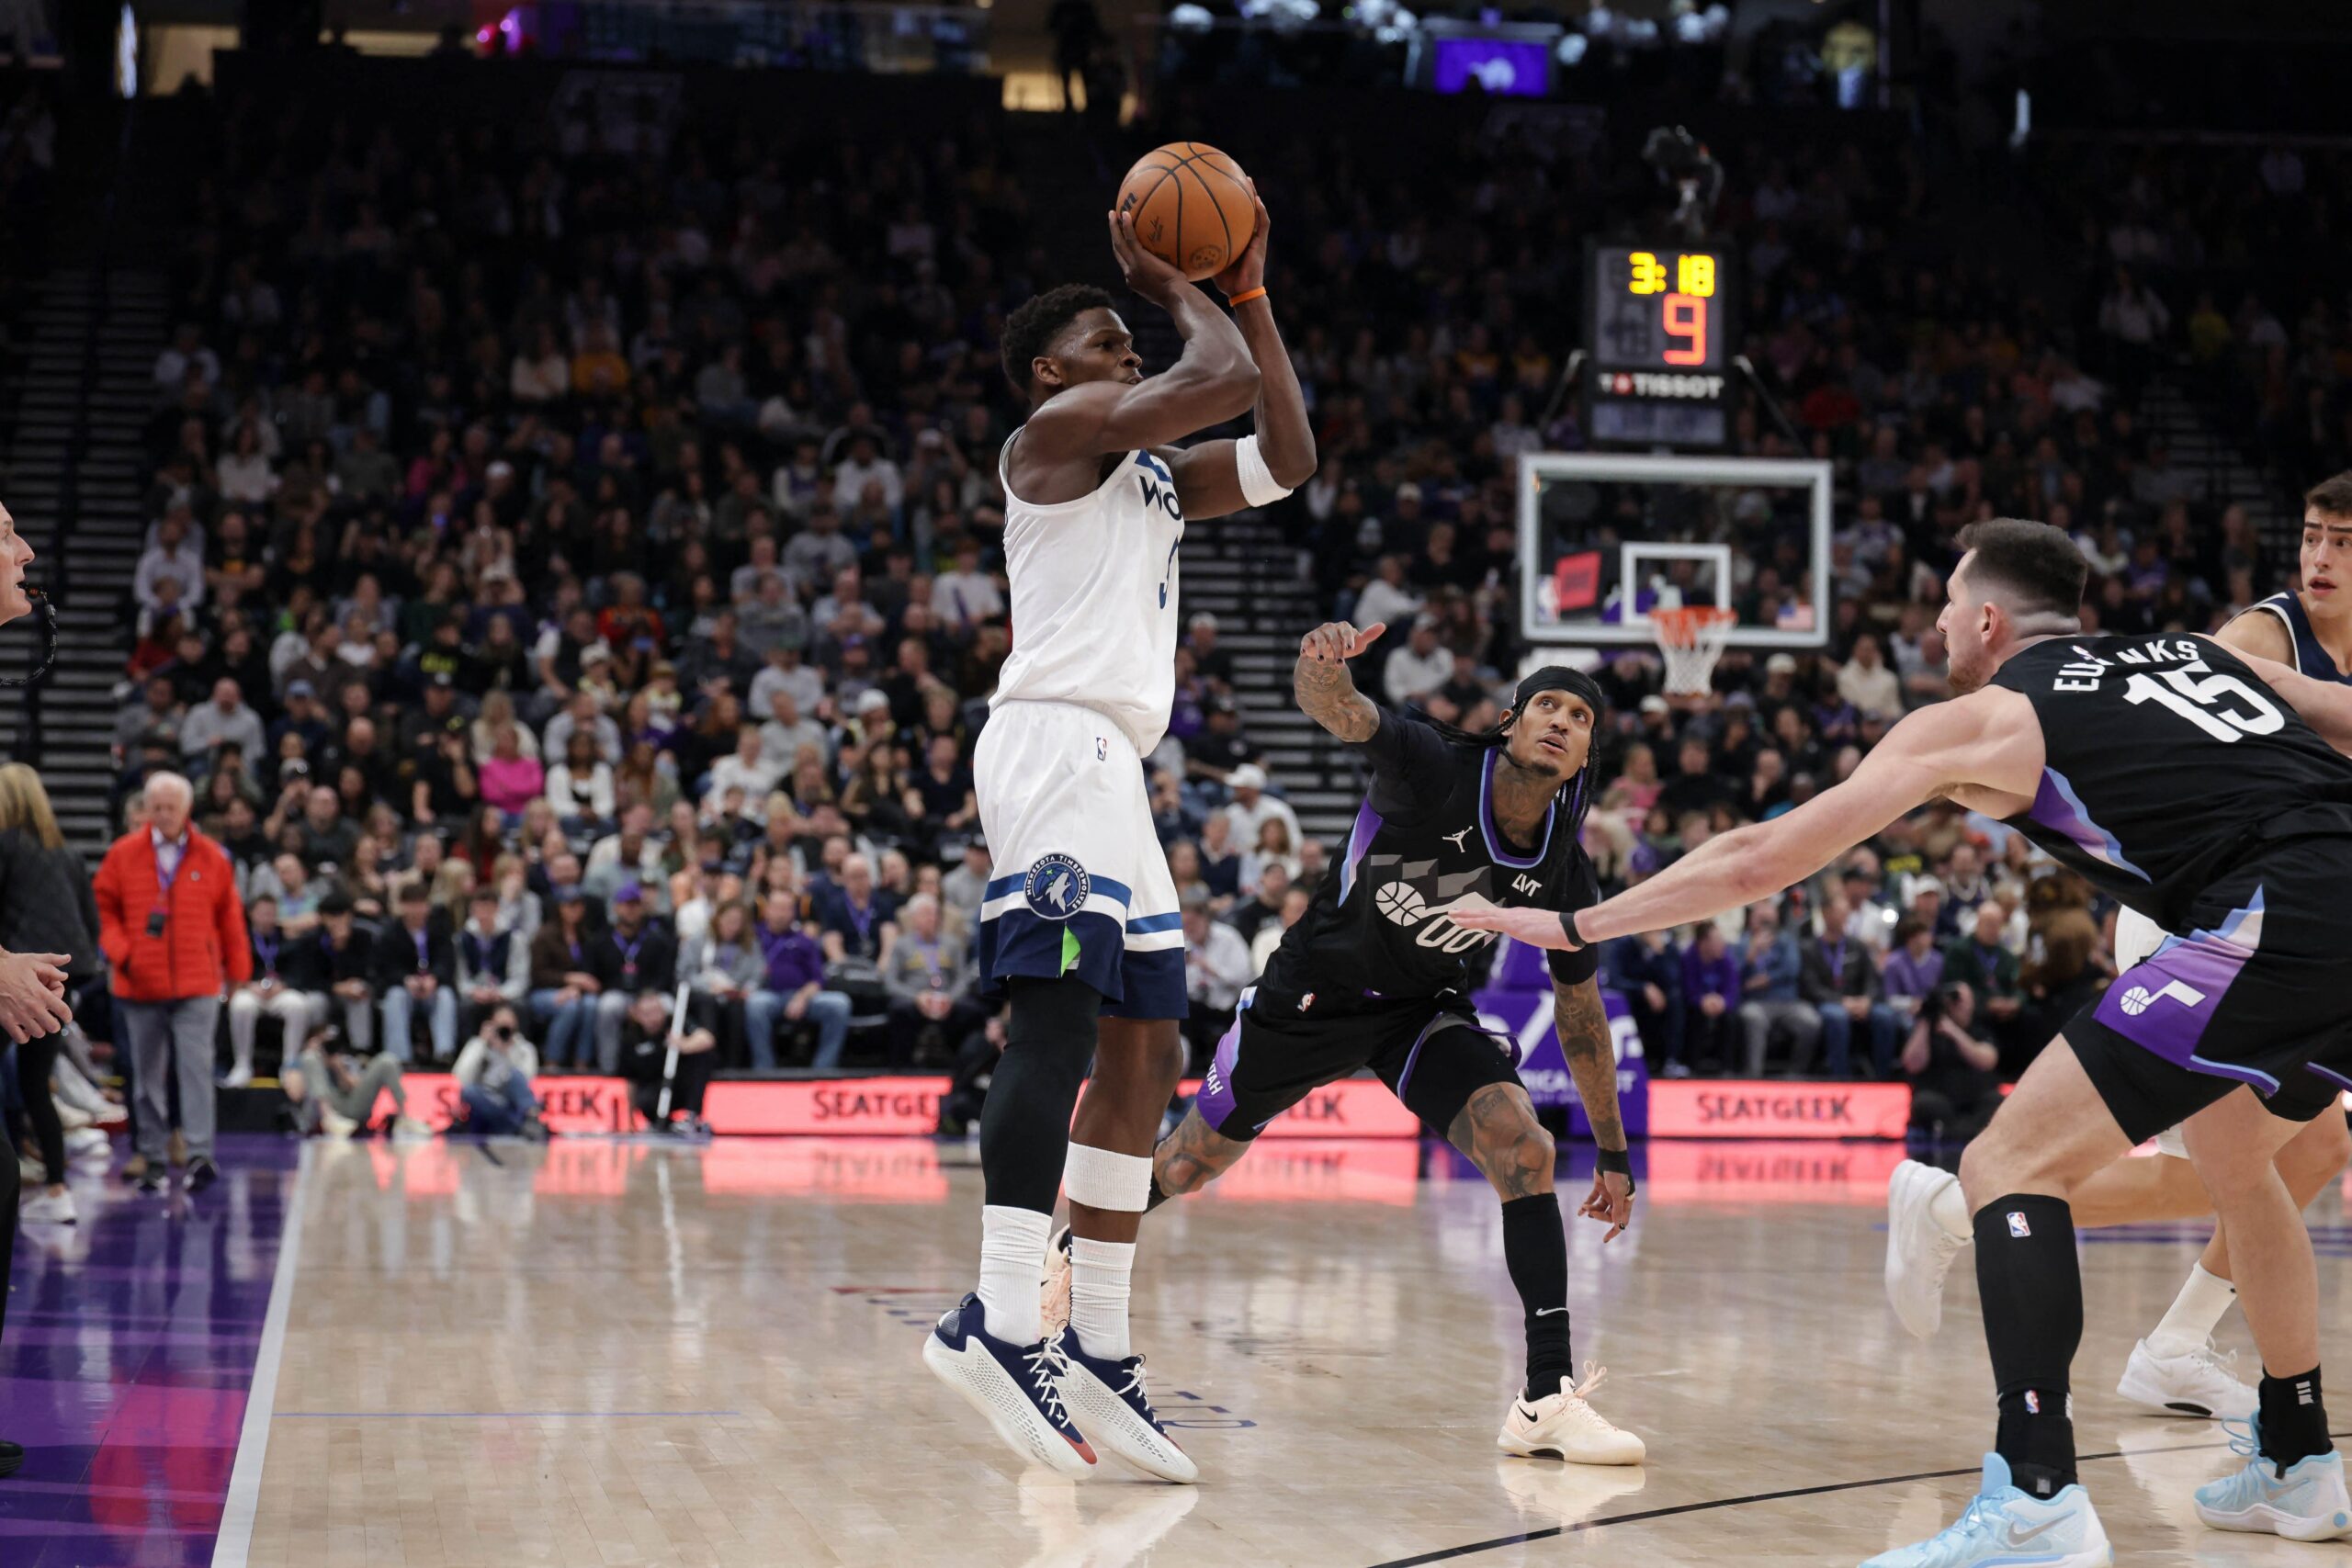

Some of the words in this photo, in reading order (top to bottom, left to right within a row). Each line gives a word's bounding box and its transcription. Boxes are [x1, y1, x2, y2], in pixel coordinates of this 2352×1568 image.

[1629, 253, 1715, 297] 3:18
[1663, 293, 1707, 366] 9
[1633, 373, 1724, 399] TISSOT
[2122, 660, 2285, 742] 15
[1026, 855, 1056, 896] MINNESOTA
[1059, 855, 1087, 909] TIMBERWOLVES
[1697, 1092, 1854, 1124] SEATGEEK
